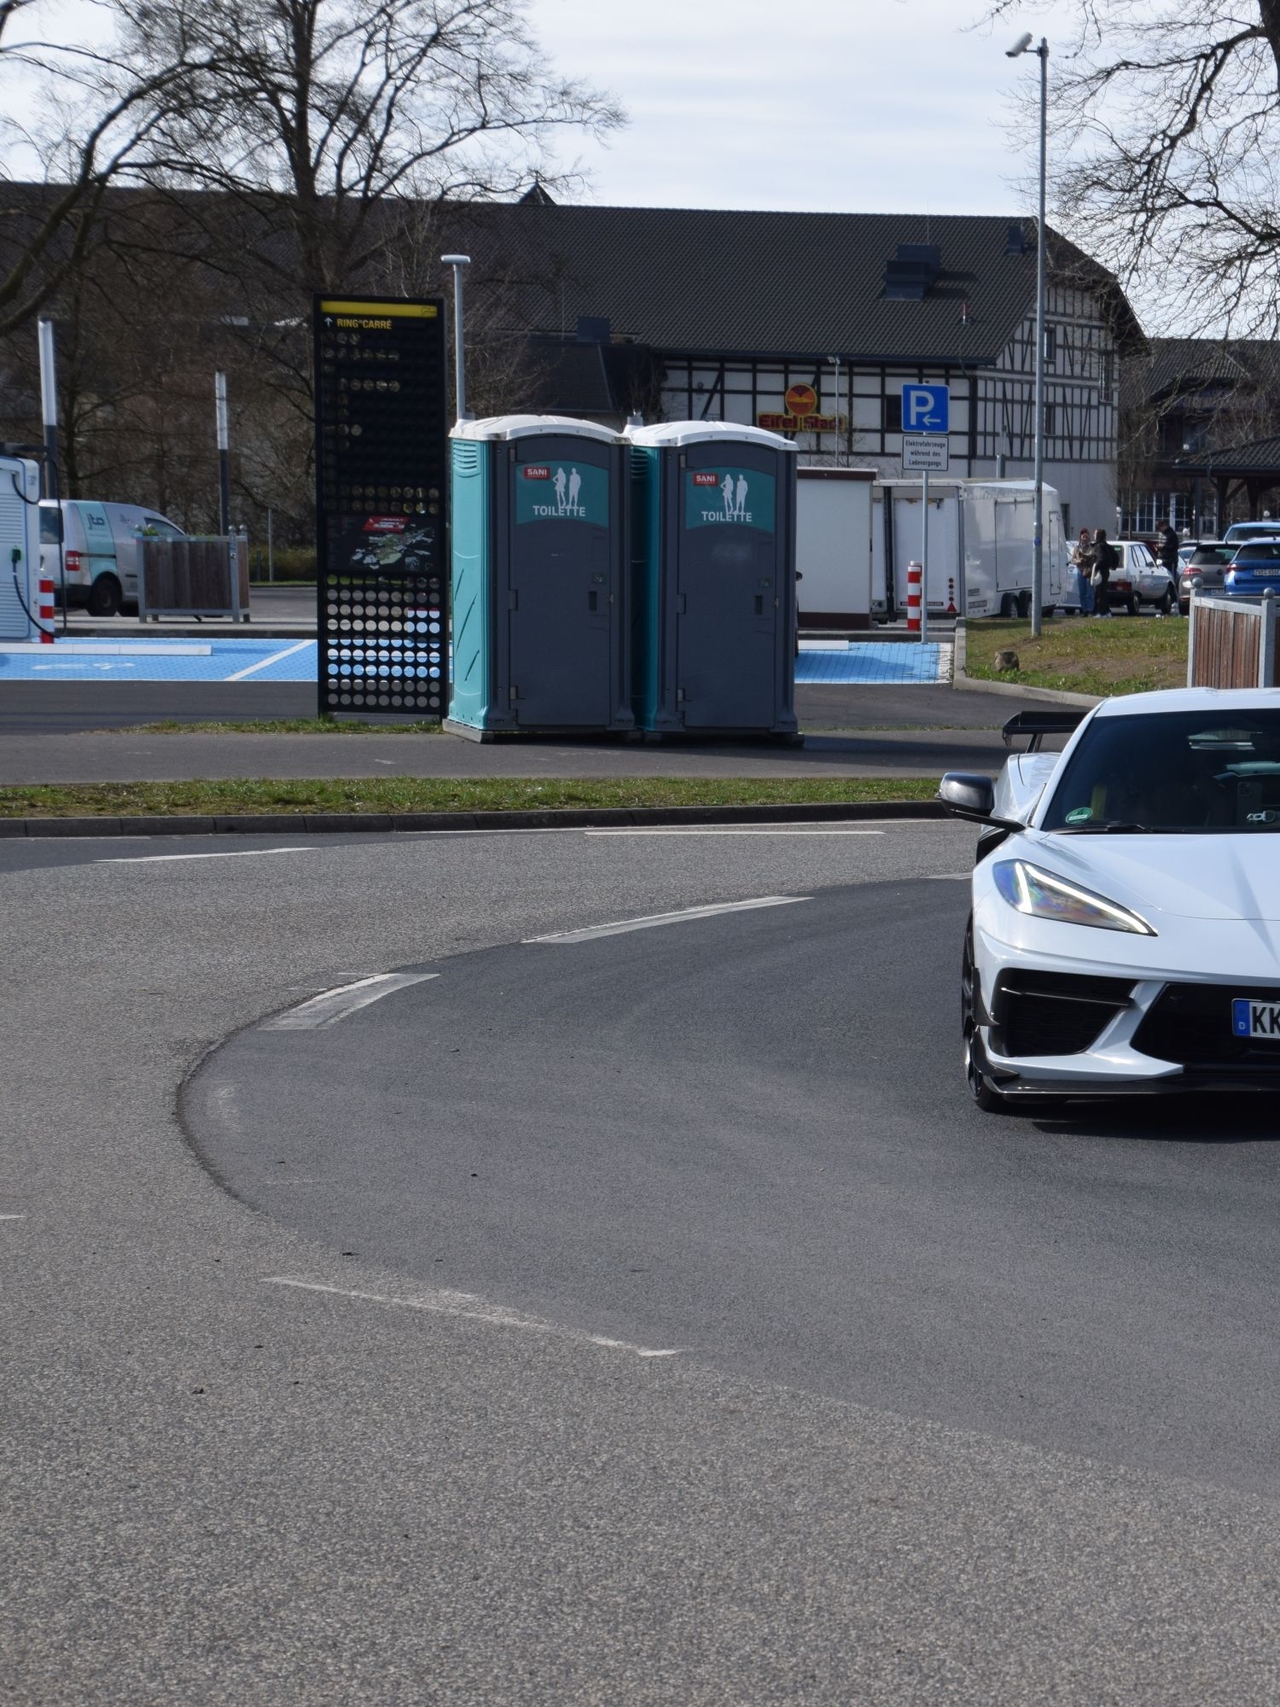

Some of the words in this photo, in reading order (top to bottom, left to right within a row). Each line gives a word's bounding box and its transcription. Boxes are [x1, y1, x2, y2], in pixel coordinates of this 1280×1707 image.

[909, 391, 935, 426] P
[758, 415, 797, 428] Eifel
[905, 440, 946, 449] Elektrofahrzeuge
[908, 459, 942, 467] Ladevorgangs
[527, 468, 547, 476] SANI
[696, 474, 716, 483] SANI
[532, 505, 586, 517] TOILETTE
[701, 511, 753, 522] TOILETTE
[1238, 1022, 1246, 1030] D
